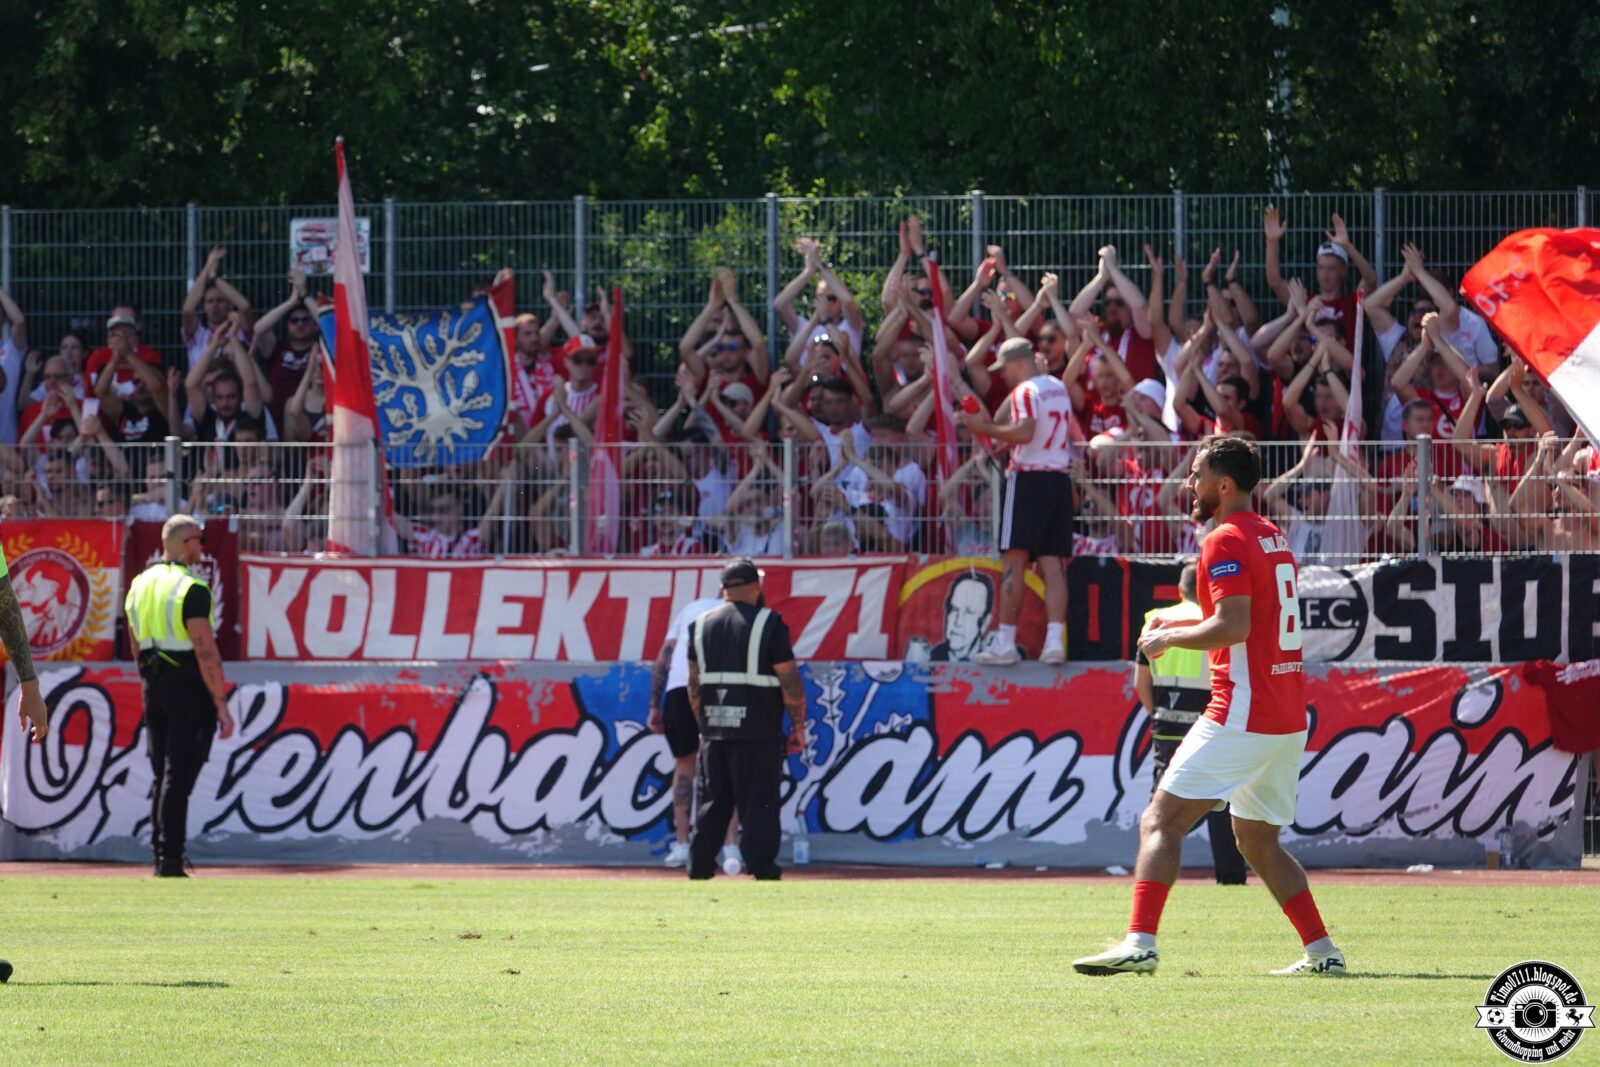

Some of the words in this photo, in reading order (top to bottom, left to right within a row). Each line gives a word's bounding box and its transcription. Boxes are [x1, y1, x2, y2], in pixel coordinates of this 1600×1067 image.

[1043, 411, 1070, 449] 71
[246, 566, 722, 661] KOLLEKTI
[790, 567, 892, 660] 71
[1275, 563, 1303, 651] 8
[1300, 600, 1360, 629] .F.C.
[818, 722, 1086, 841] am
[1104, 679, 1580, 838] ain
